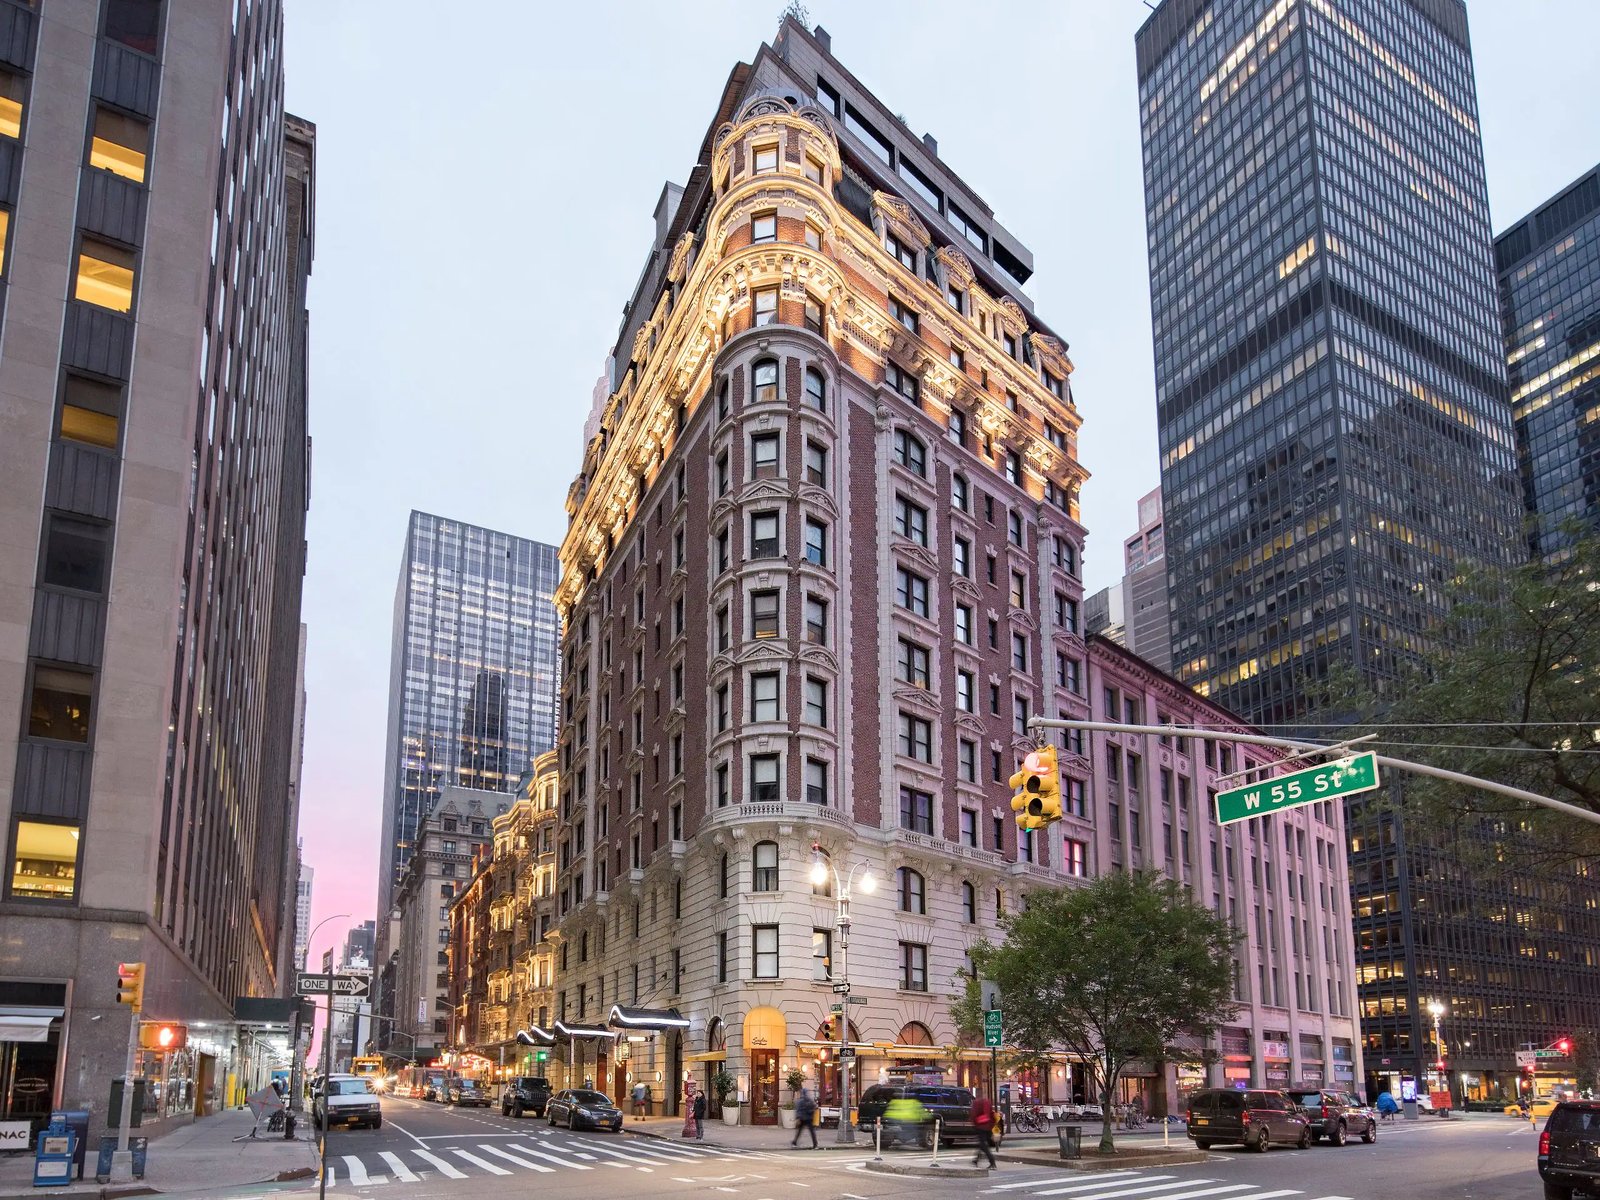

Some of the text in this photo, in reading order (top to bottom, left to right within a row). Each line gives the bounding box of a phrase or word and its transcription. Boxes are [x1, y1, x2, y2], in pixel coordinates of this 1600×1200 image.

[1244, 770, 1343, 810] W 55 St
[303, 980, 360, 990] ONE WAY
